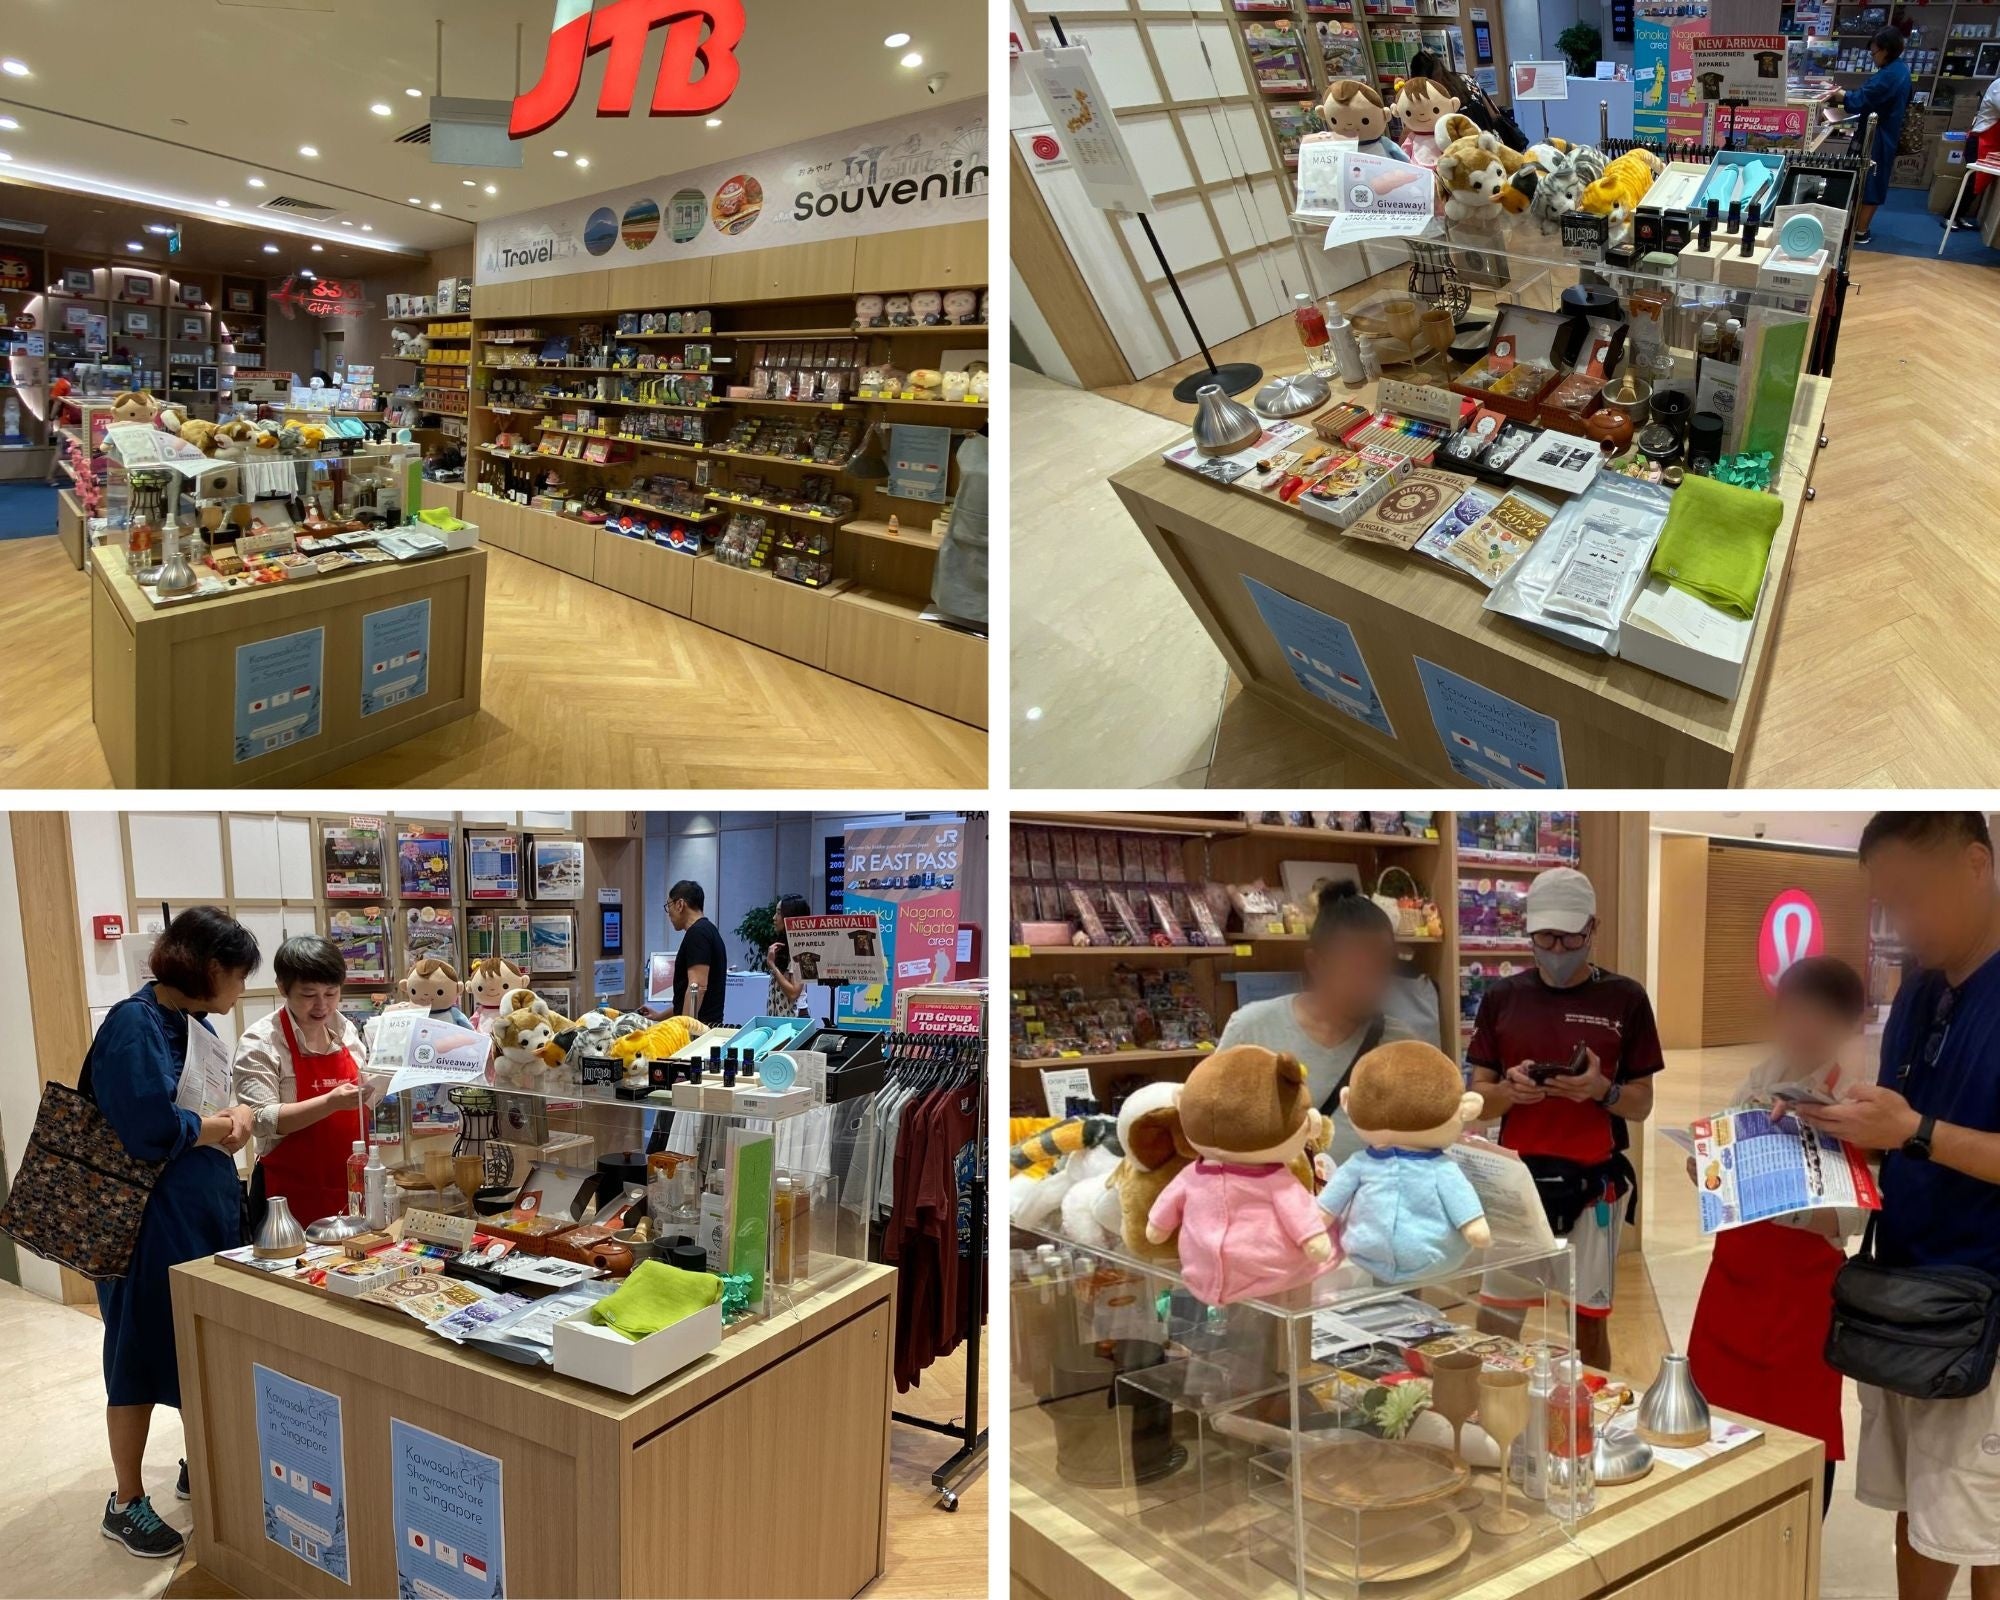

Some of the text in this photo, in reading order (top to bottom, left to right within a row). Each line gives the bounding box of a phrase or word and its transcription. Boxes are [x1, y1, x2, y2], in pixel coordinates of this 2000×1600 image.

[1636, 29, 1668, 40] Tohoku
[1650, 42, 1668, 50] area
[1698, 38, 1778, 49] NEW ARRIVAL!!
[508, 0, 747, 140] JTB
[1735, 115, 1760, 124] Group
[1743, 123, 1780, 132] Packages
[798, 162, 832, 176] おみやげ
[1377, 200, 1426, 211] Giveaway!
[502, 239, 553, 268] Travel
[308, 302, 332, 315] Gift
[1444, 475, 1467, 488] MILK
[1355, 522, 1390, 535] PANCAKE
[1394, 532, 1410, 541] MIX
[1437, 678, 1506, 719] Kawasaki
[1463, 710, 1538, 752] Singapore
[935, 829, 958, 843] JR
[847, 851, 958, 872] JR EAST PASS
[900, 907, 955, 919] Nagano,
[792, 917, 871, 930] NEW ARRIVAL!!
[909, 922, 955, 935] Niigata
[788, 930, 840, 938] TRANSFORMERS
[927, 937, 954, 946] area
[911, 1012, 972, 1024] JTB Group
[919, 1022, 947, 1031] Tour
[436, 1057, 479, 1069] Giveaway!
[265, 1384, 328, 1426] Kawasaki City
[269, 1418, 328, 1455] in Singapore
[405, 1444, 485, 1493] Kawasaki City
[408, 1481, 483, 1525] in Singapore
